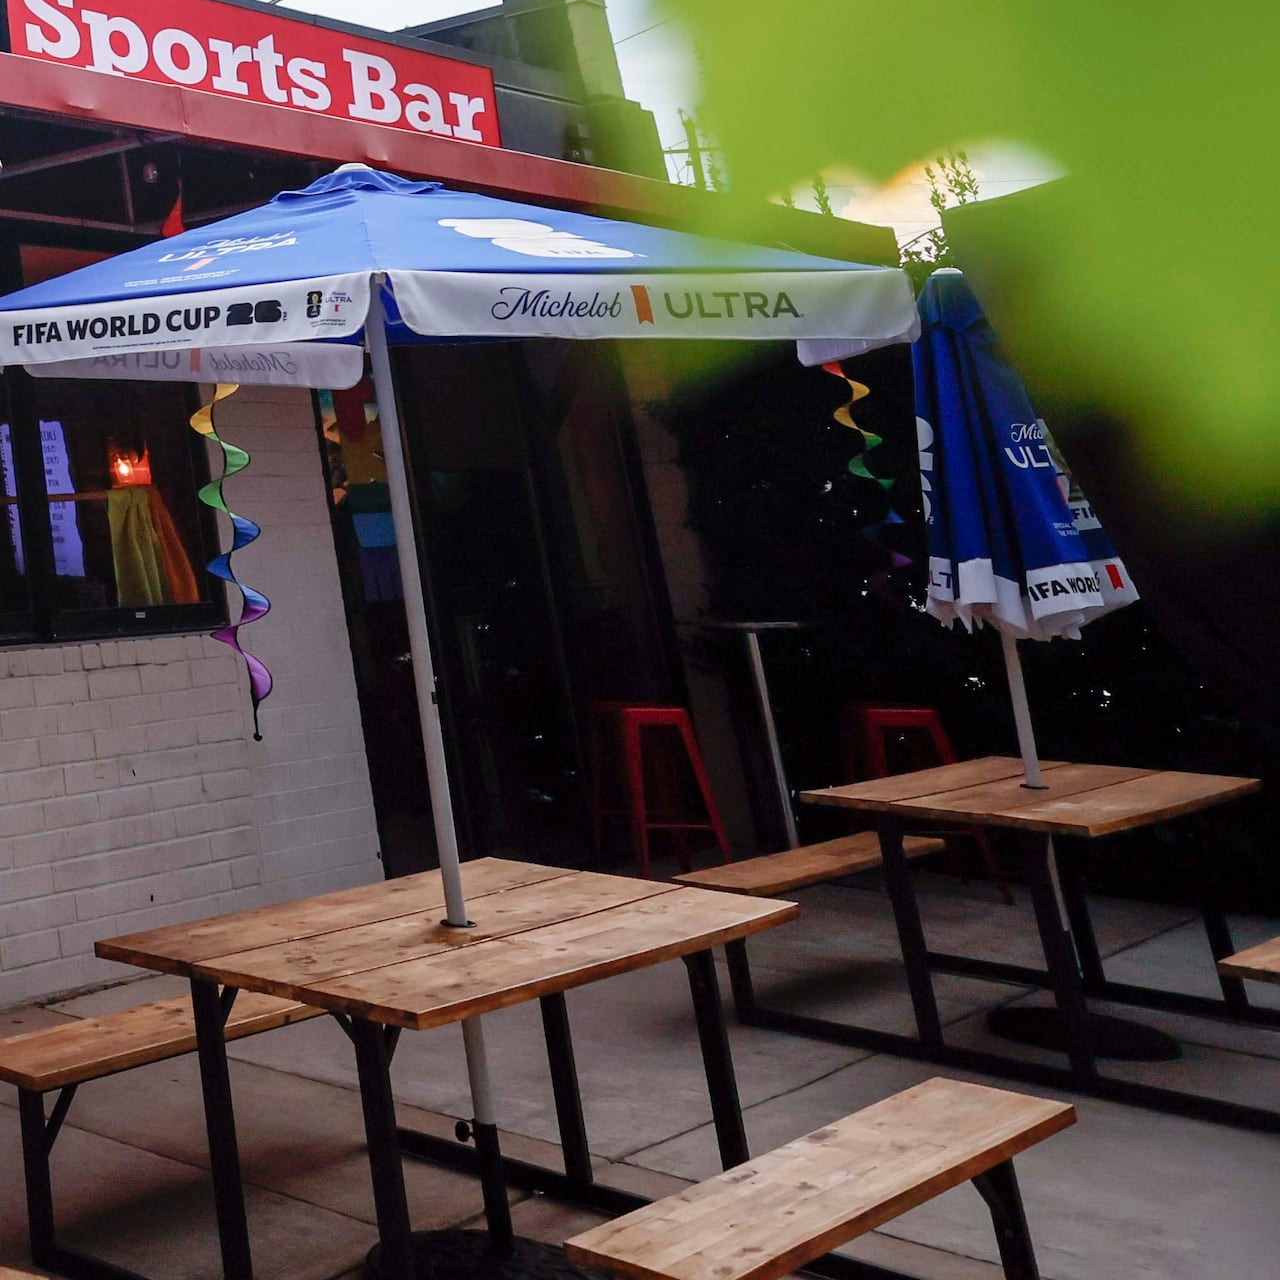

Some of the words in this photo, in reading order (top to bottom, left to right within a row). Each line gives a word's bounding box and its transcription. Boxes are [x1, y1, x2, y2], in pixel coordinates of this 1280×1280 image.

[343, 49, 486, 142] Bar
[491, 286, 622, 320] Michelob
[664, 291, 801, 319] ULTRA
[13, 321, 62, 346] FIFA
[67, 312, 160, 340] WORLD
[166, 306, 221, 332] CUP
